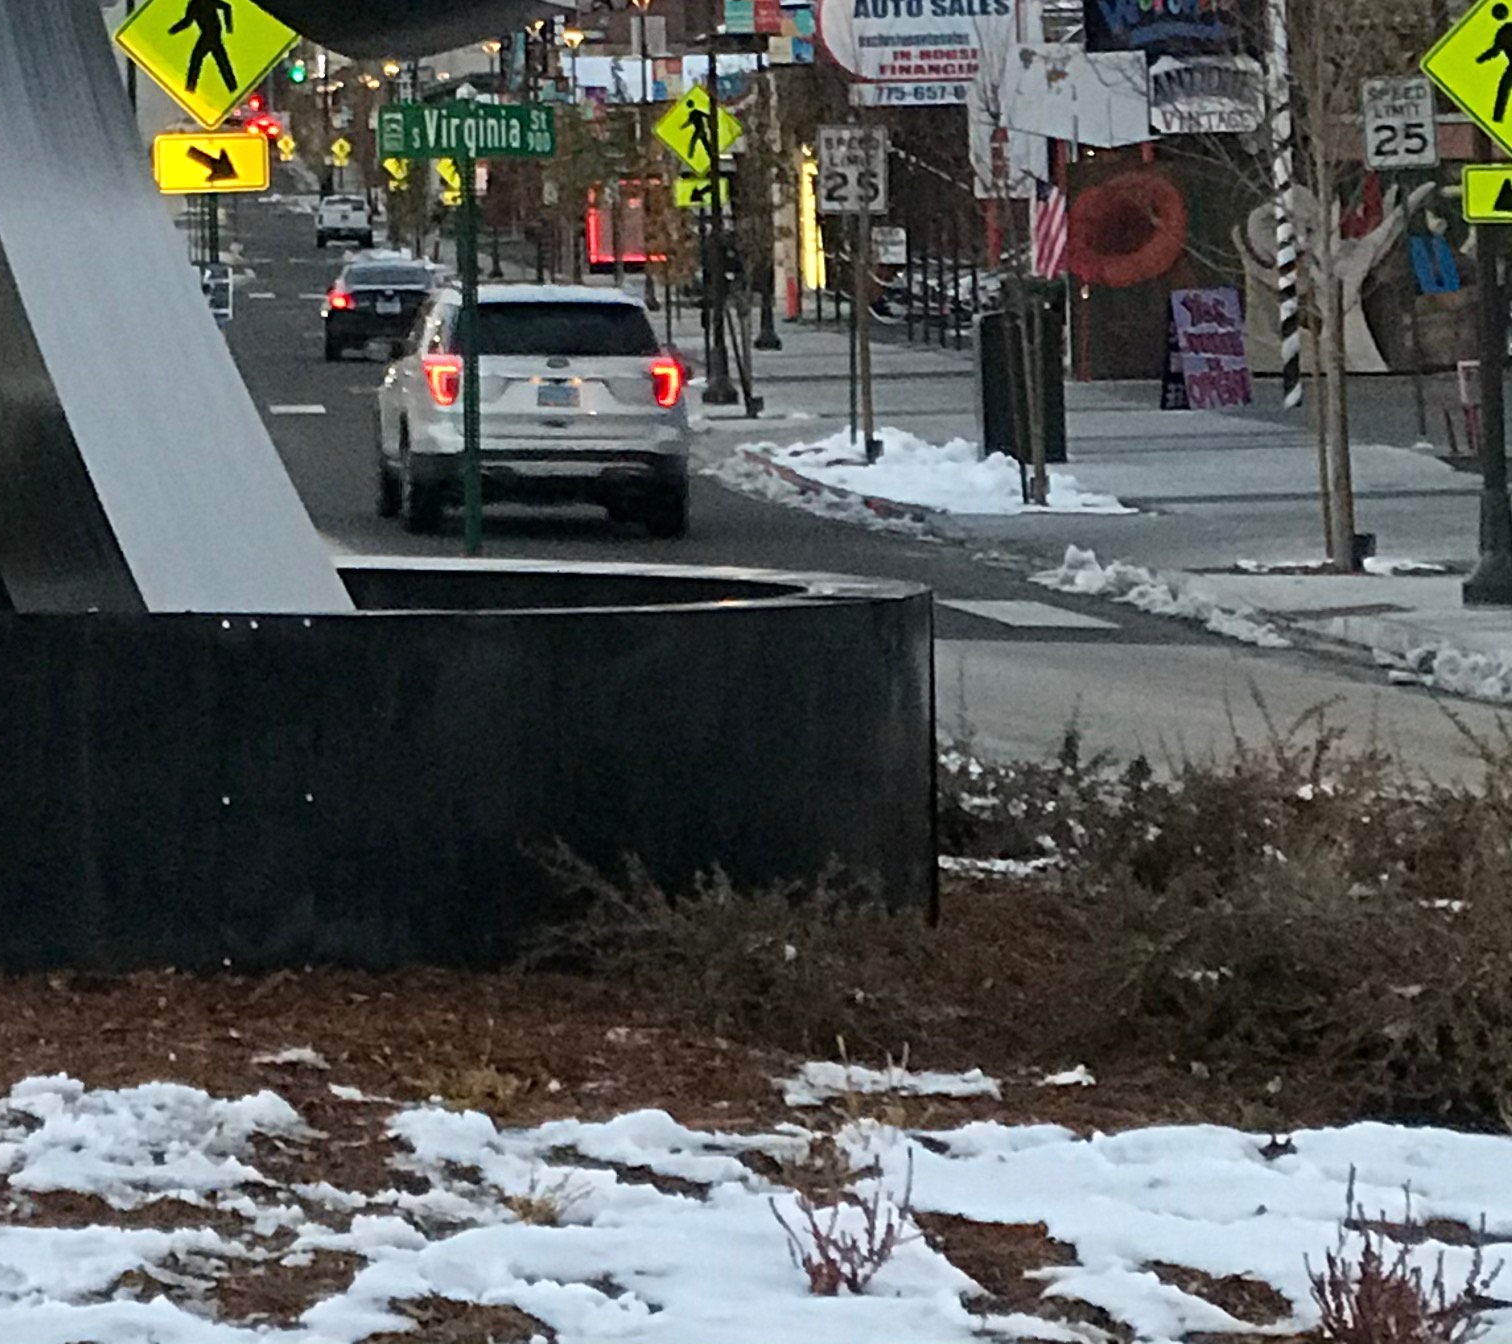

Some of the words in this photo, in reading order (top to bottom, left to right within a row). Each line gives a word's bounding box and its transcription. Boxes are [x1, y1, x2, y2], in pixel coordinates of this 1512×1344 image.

[879, 63, 979, 76] FINANCIN
[424, 109, 521, 158] Virginia
[529, 111, 547, 130] St
[1374, 123, 1428, 156] 25
[824, 171, 880, 203] 25
